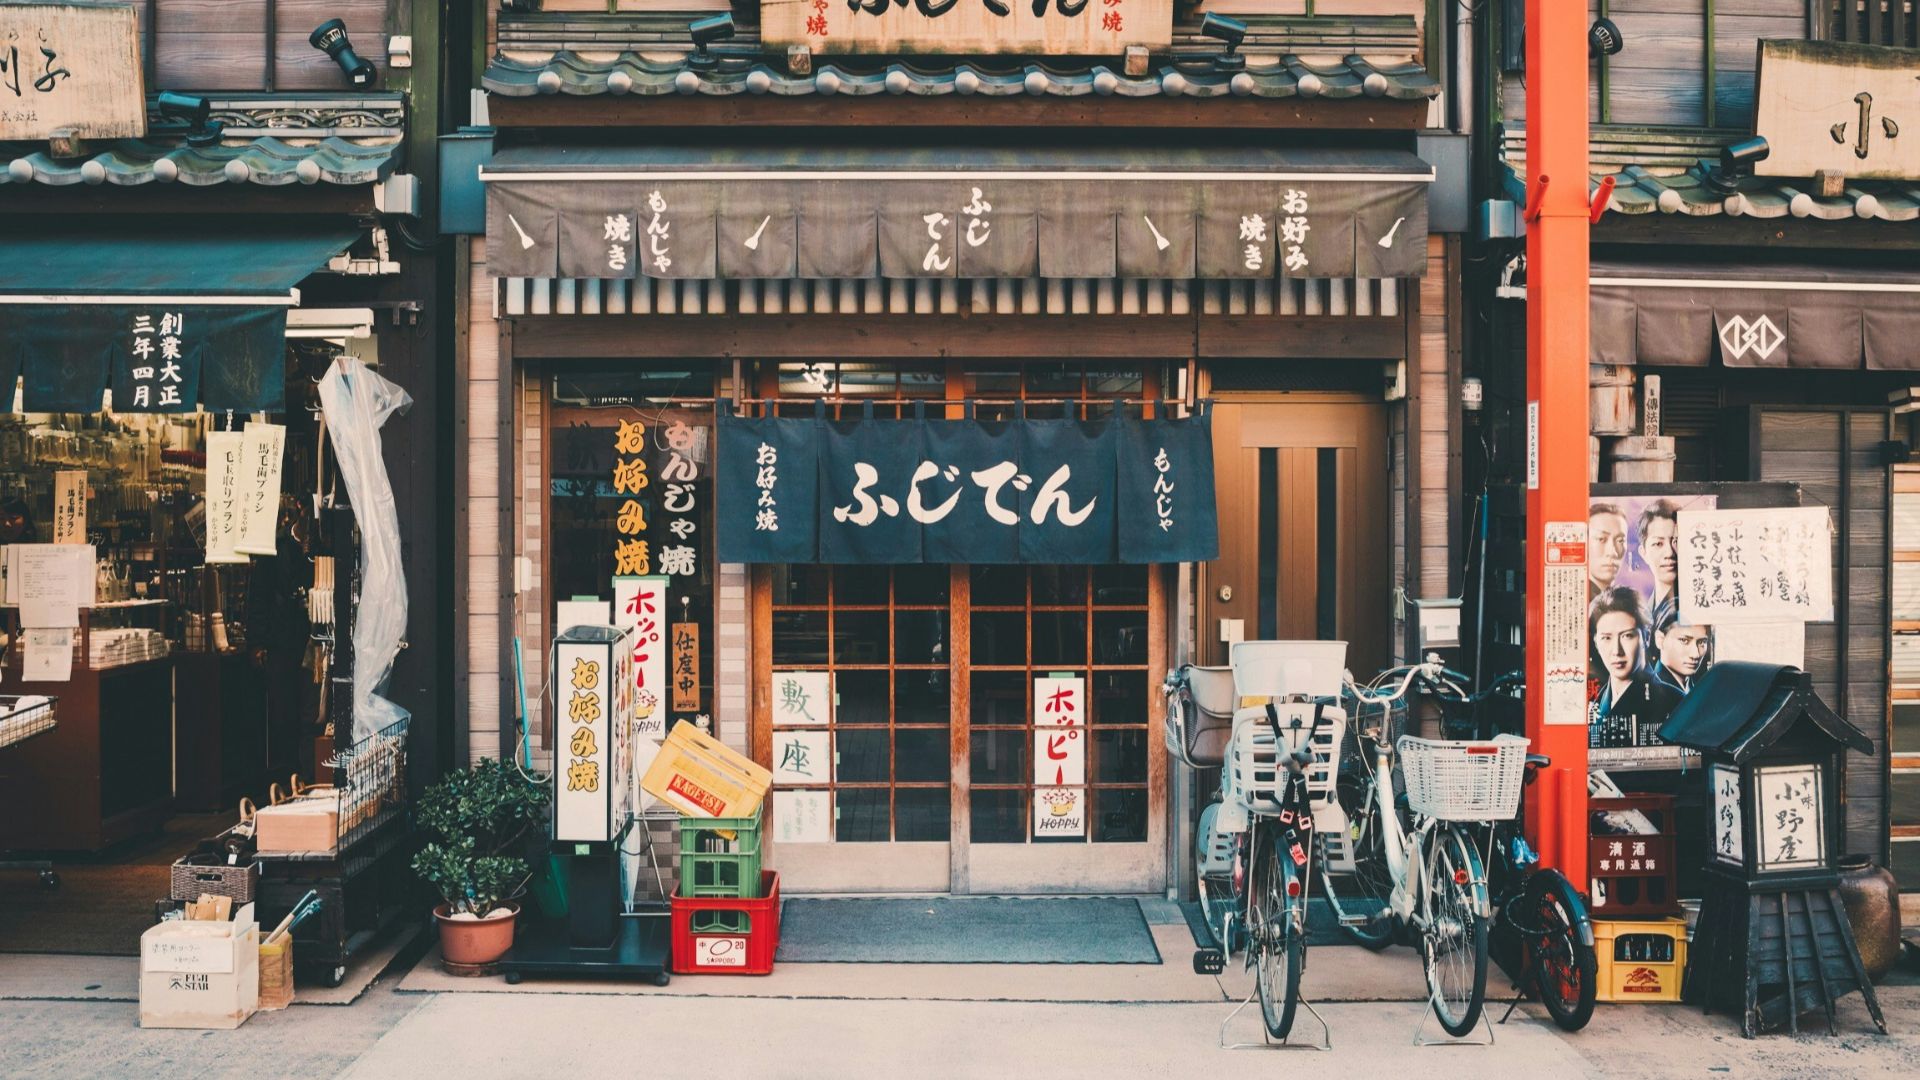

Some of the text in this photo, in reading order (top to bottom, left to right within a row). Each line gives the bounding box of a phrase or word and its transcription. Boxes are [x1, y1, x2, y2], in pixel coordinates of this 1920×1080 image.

[1830, 92, 1898, 159] 小
[603, 214, 631, 270] 焼き
[647, 190, 671, 273] もんじゃ
[922, 212, 951, 271] でん
[963, 187, 992, 247] ふじ
[1239, 213, 1267, 270] 焼き
[1282, 189, 1311, 271] お好み
[132, 314, 155, 408] 三年四月
[158, 312, 183, 406] 創業大正
[613, 418, 650, 576] お好み焼
[658, 420, 697, 576] もんじゃ焼
[755, 442, 779, 532] お好み焼
[833, 460, 1097, 527] ふじでん
[1154, 447, 1174, 532] もんじゃ
[675, 630, 696, 696] 仕度中
[567, 657, 601, 793] お好み焼
[1045, 684, 1078, 786] ホッピー
[1039, 817, 1080, 830] HOPPY
[735, 941, 744, 950] 20
[185, 983, 209, 991] STAR
